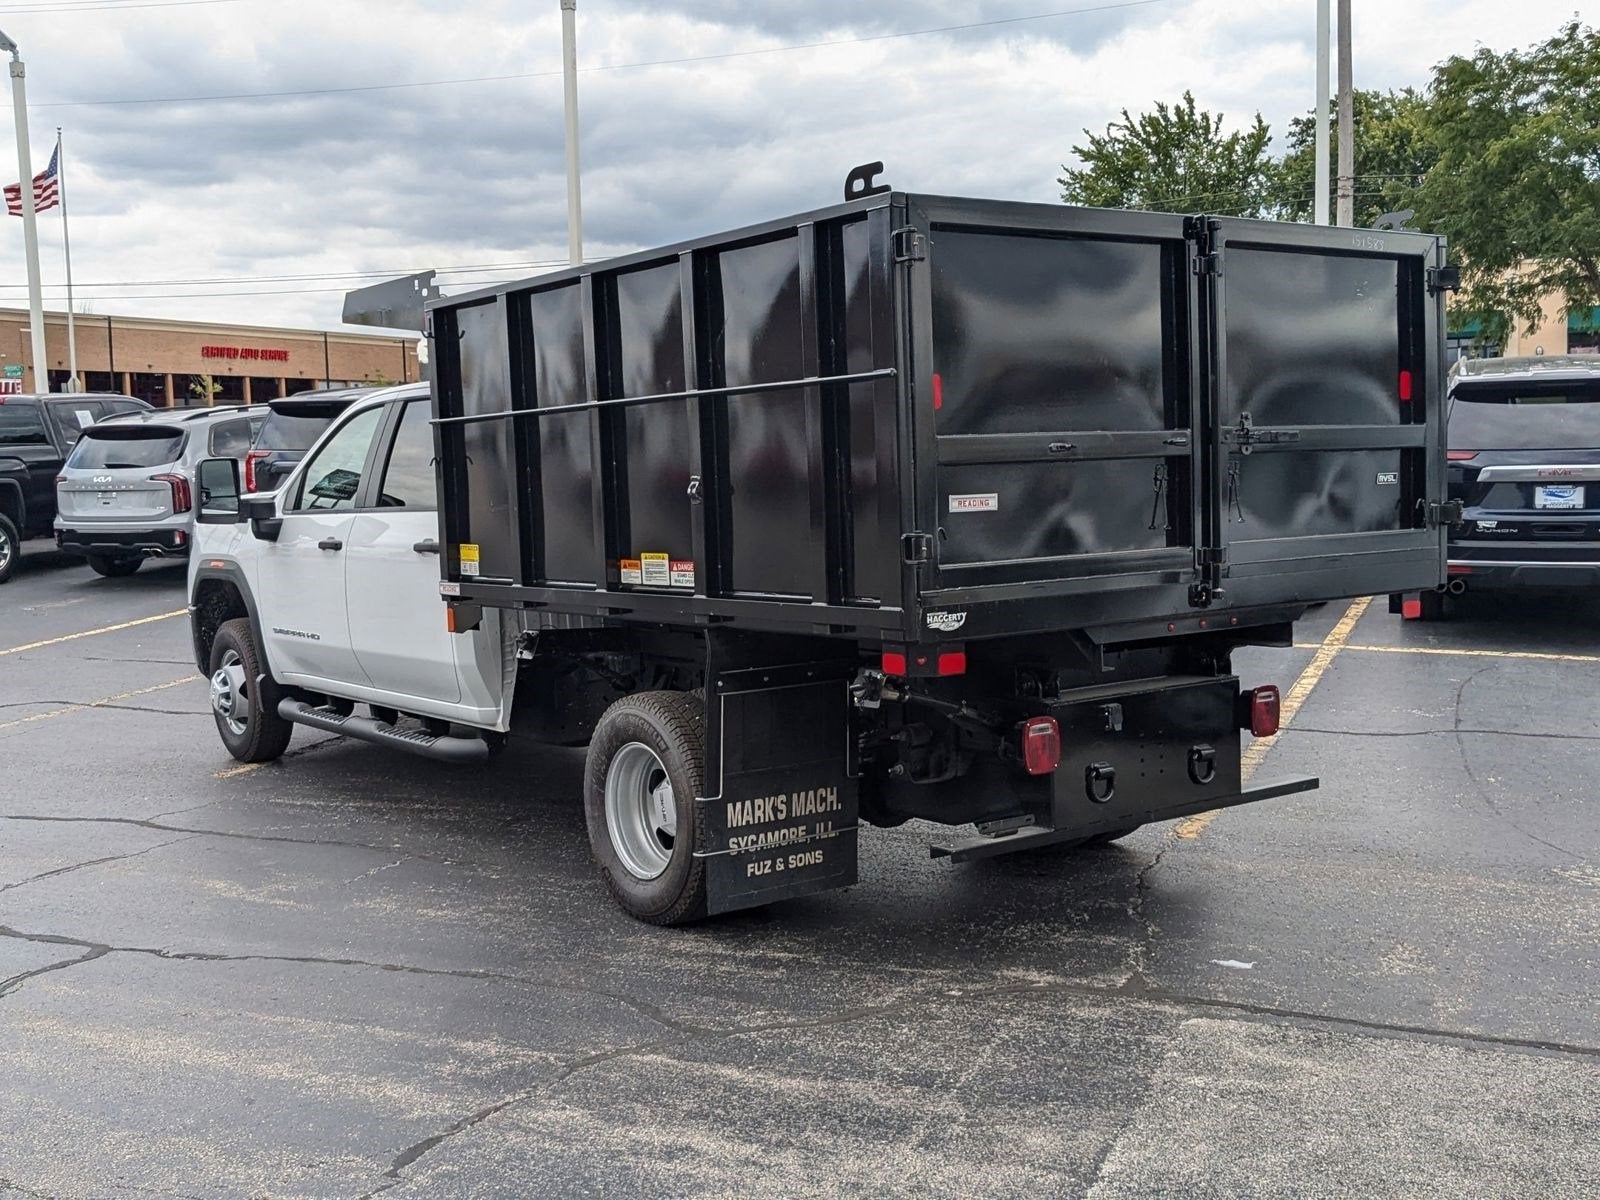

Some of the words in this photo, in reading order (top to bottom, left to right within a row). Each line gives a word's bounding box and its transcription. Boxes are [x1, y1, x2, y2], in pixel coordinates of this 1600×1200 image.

[240, 348, 259, 360] AUTO
[260, 349, 289, 361] SERVICE
[957, 499, 990, 508] READING
[677, 563, 694, 571] DANGE
[727, 795, 786, 828] MARK'S
[791, 787, 842, 818] MACH.
[747, 860, 772, 877] FUZ
[775, 857, 785, 871] &
[788, 850, 823, 868] SONS
